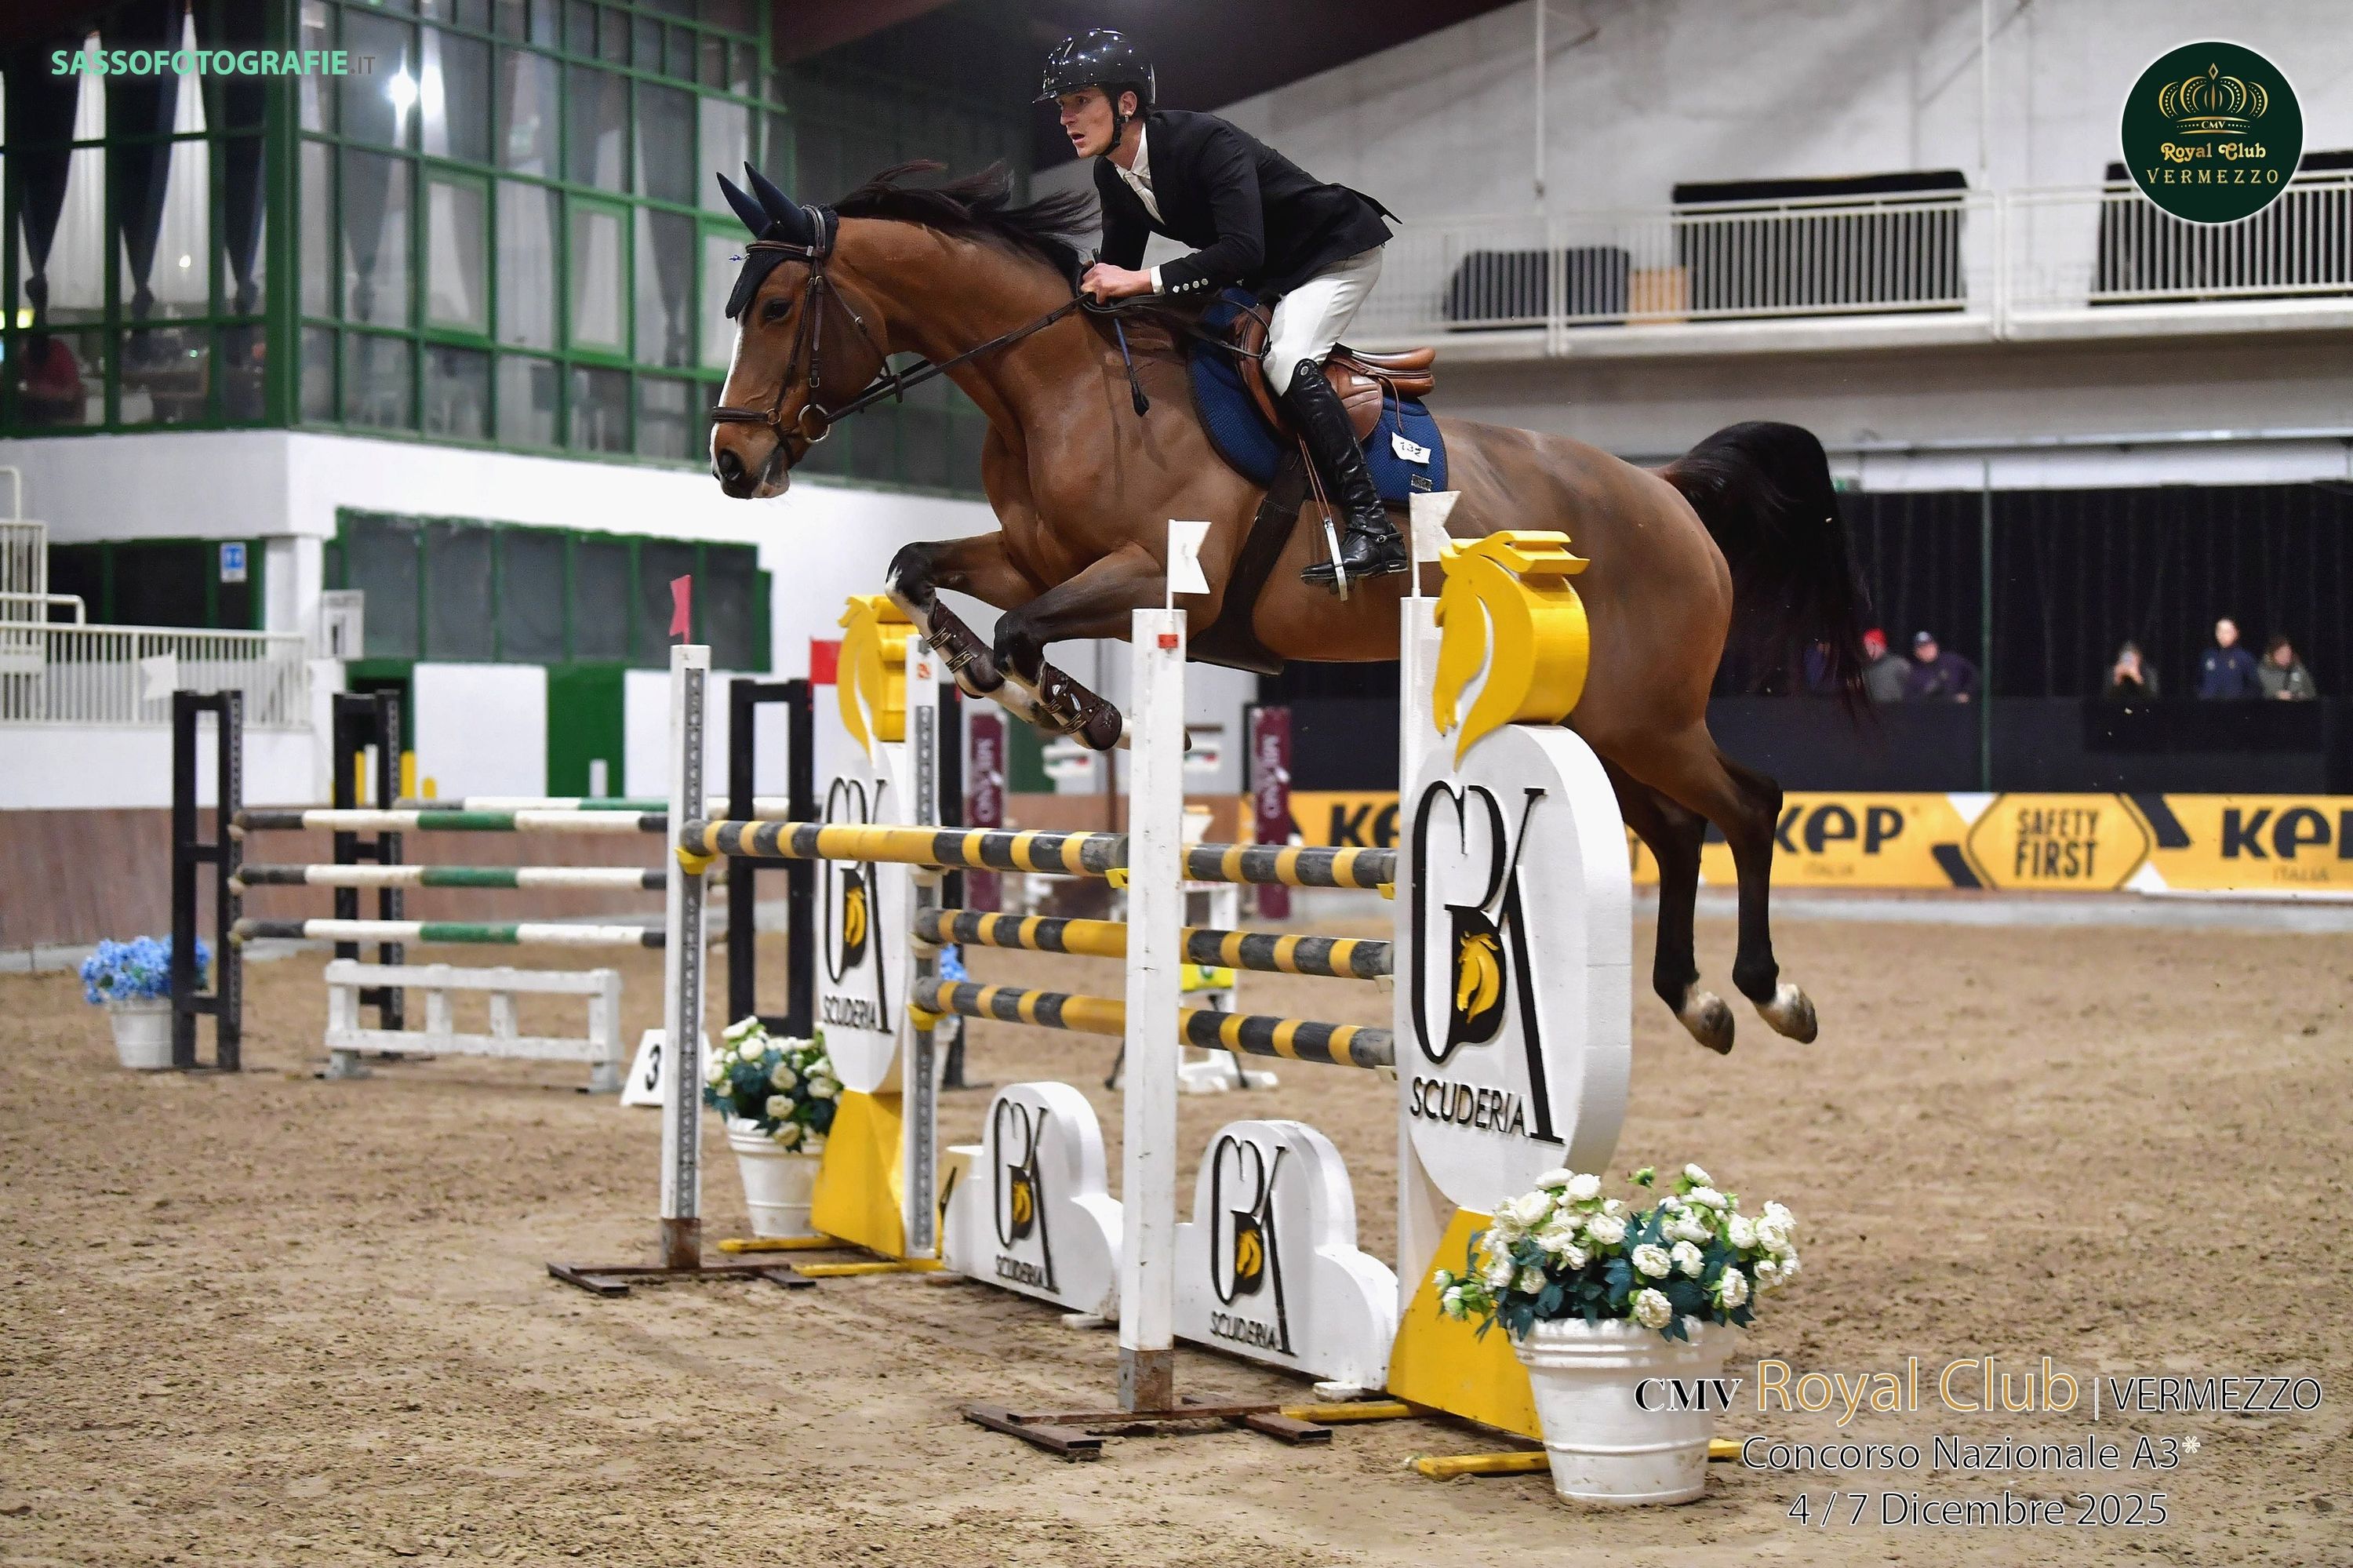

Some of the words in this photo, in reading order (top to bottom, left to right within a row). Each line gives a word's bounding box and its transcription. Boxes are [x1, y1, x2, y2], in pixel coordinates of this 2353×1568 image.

[2017, 807, 2100, 835] SAFETY
[2013, 839, 2097, 880] FIRST
[645, 1043, 662, 1093] 3
[1410, 1075, 1528, 1137] SCUDERIA
[1209, 1311, 1279, 1350] SCUDERIA
